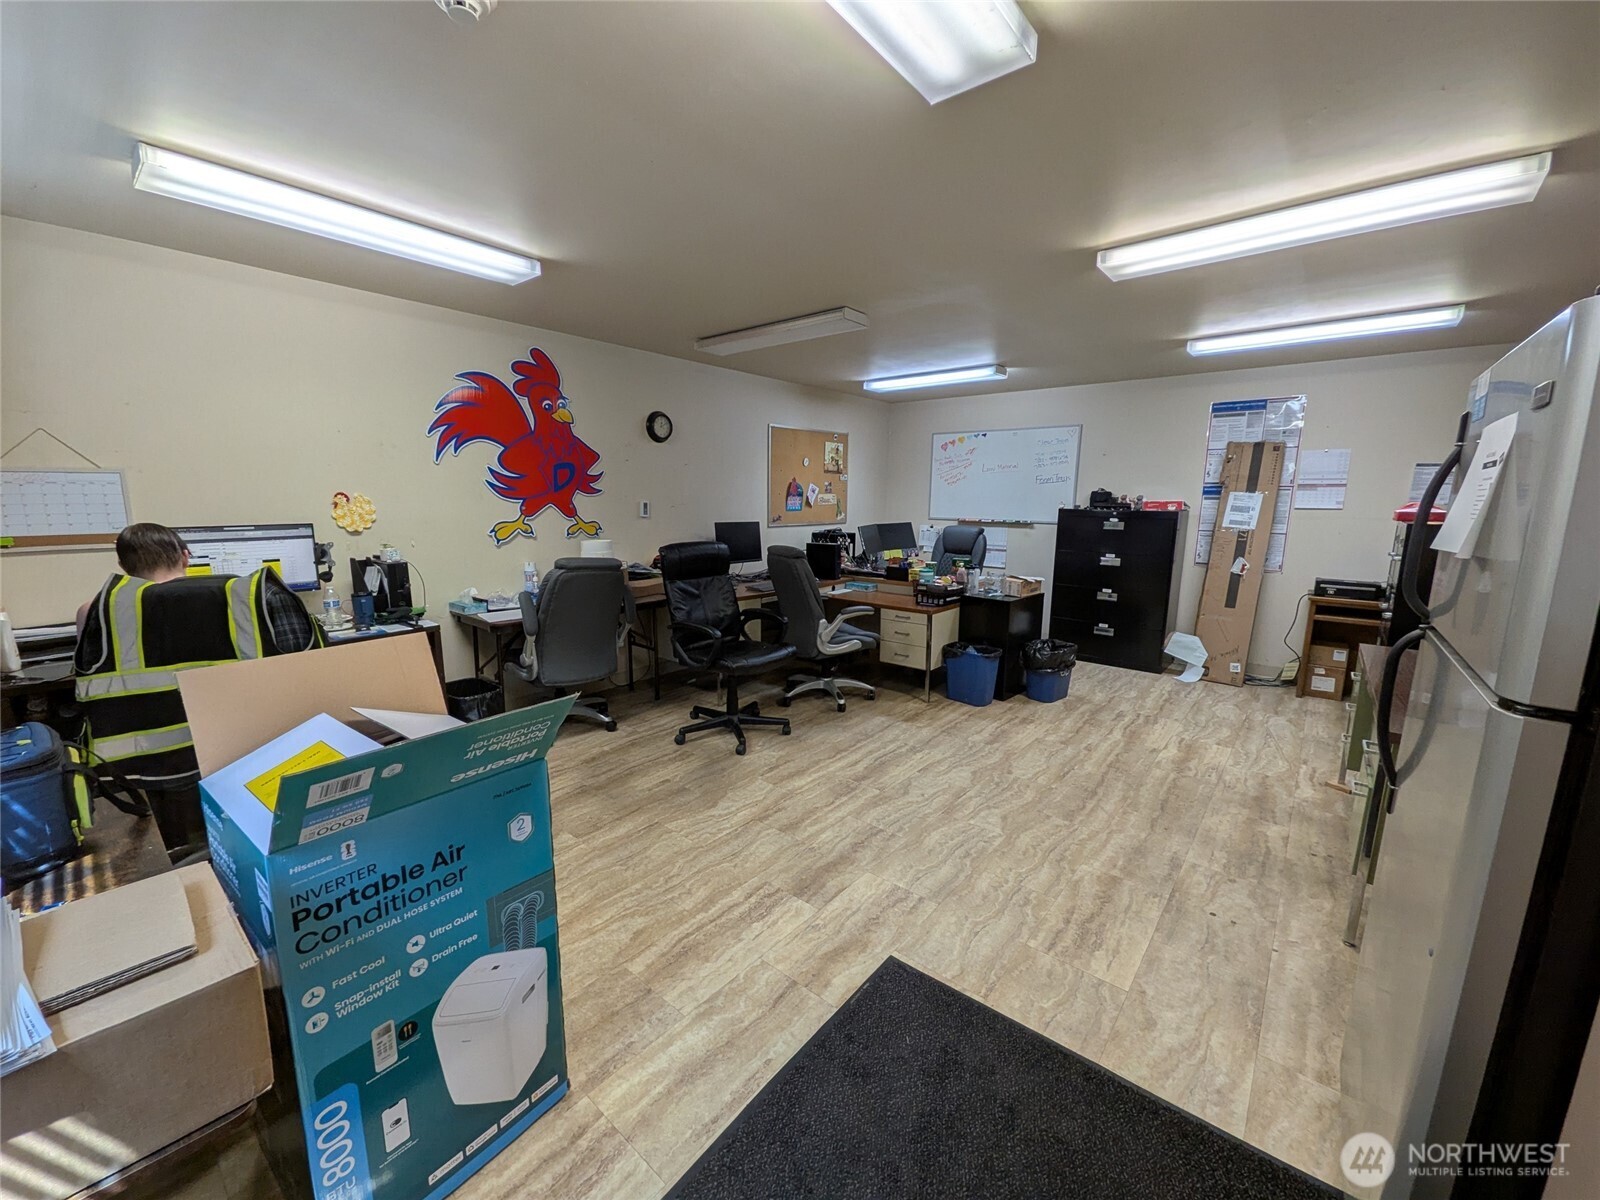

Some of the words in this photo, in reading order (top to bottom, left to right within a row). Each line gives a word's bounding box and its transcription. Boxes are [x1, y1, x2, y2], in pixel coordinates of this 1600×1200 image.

[553, 462, 575, 492] D
[467, 721, 551, 751] Conditioner
[488, 729, 547, 751] Portable
[451, 749, 538, 783] Hisense
[464, 746, 486, 760] Air
[316, 815, 365, 836] 8000
[517, 818, 526, 831] 2
[289, 854, 333, 875] Hisense
[290, 863, 377, 909] INVERTER
[292, 863, 424, 932] Portable
[431, 844, 466, 872] Air
[295, 866, 468, 954] Conditioner
[429, 923, 452, 939] Ultra
[453, 909, 479, 926] Quiet
[299, 954, 324, 970] WITH
[356, 929, 375, 943] AND
[376, 916, 402, 933] DUAL
[403, 903, 429, 920] HOSE
[429, 887, 463, 908] SYSTEM
[431, 945, 458, 963] Drain
[458, 933, 478, 948] Free
[331, 970, 358, 989] Fast
[359, 956, 385, 975] Cool
[336, 990, 384, 1018] Window
[384, 979, 401, 994] Kit
[314, 1100, 356, 1187] 8000
[326, 1175, 356, 1200] BTU
